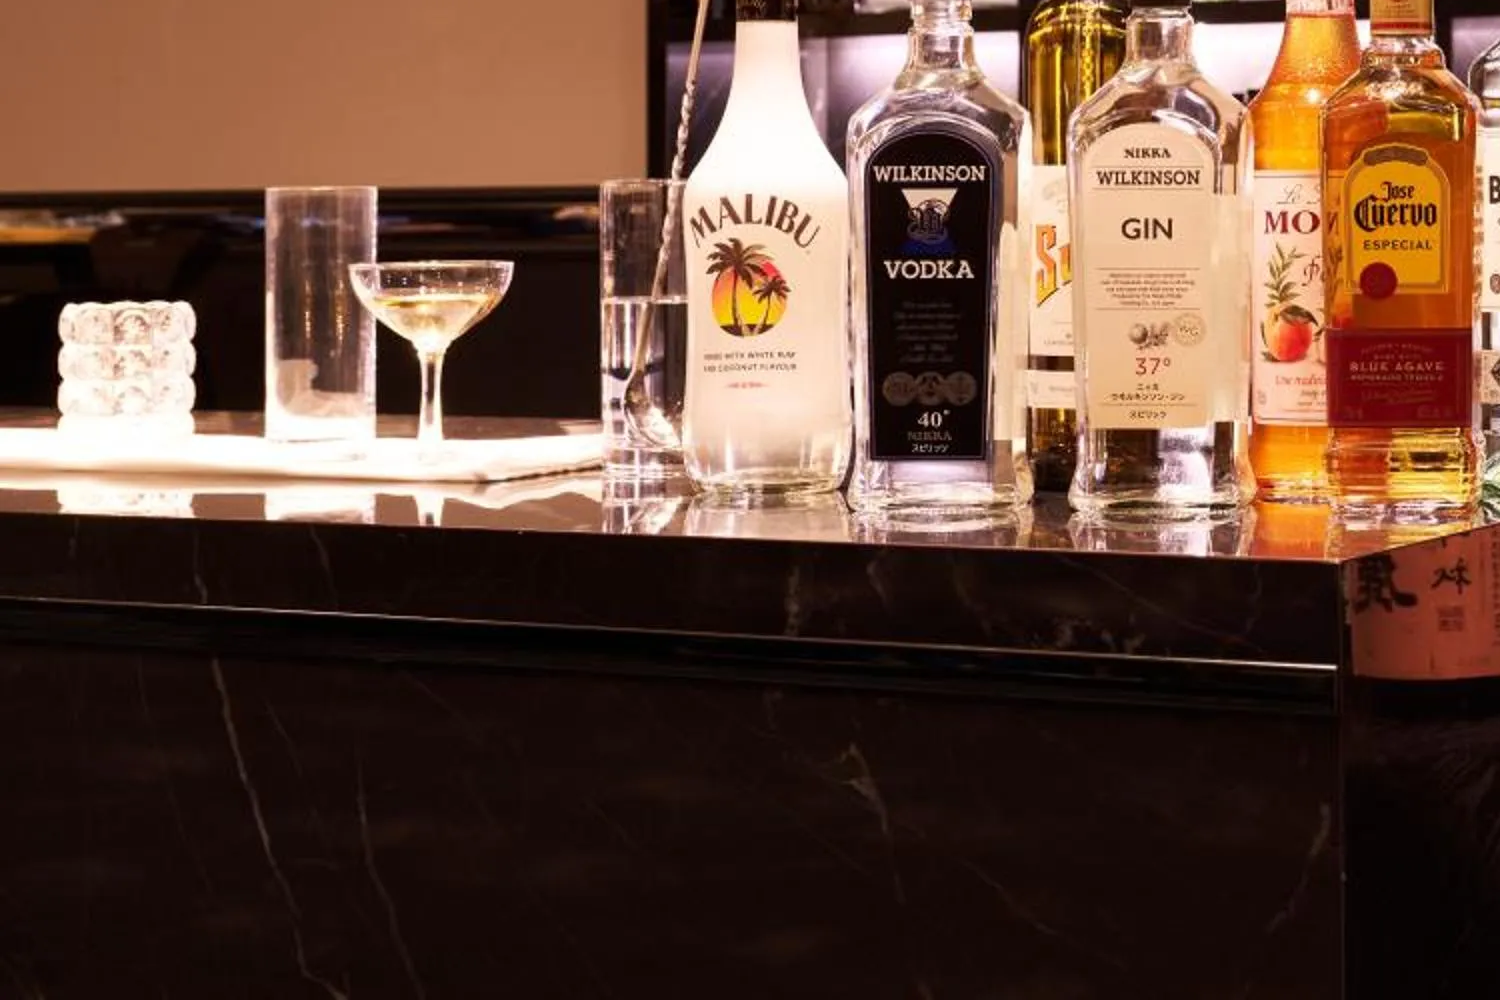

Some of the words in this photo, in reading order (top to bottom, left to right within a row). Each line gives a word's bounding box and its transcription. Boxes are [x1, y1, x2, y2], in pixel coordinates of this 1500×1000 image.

[1124, 148, 1172, 159] NIKKA
[873, 165, 986, 182] WILKINSON
[1096, 170, 1201, 185] WILKINSON
[1380, 181, 1416, 203] Jose
[690, 194, 820, 249] MALIBU
[1353, 194, 1437, 233] Cuervo
[1121, 217, 1174, 241] GIN
[1363, 240, 1433, 251] ESPECIAL
[883, 260, 975, 279] VODKA
[1395, 361, 1445, 372] AGAVE
